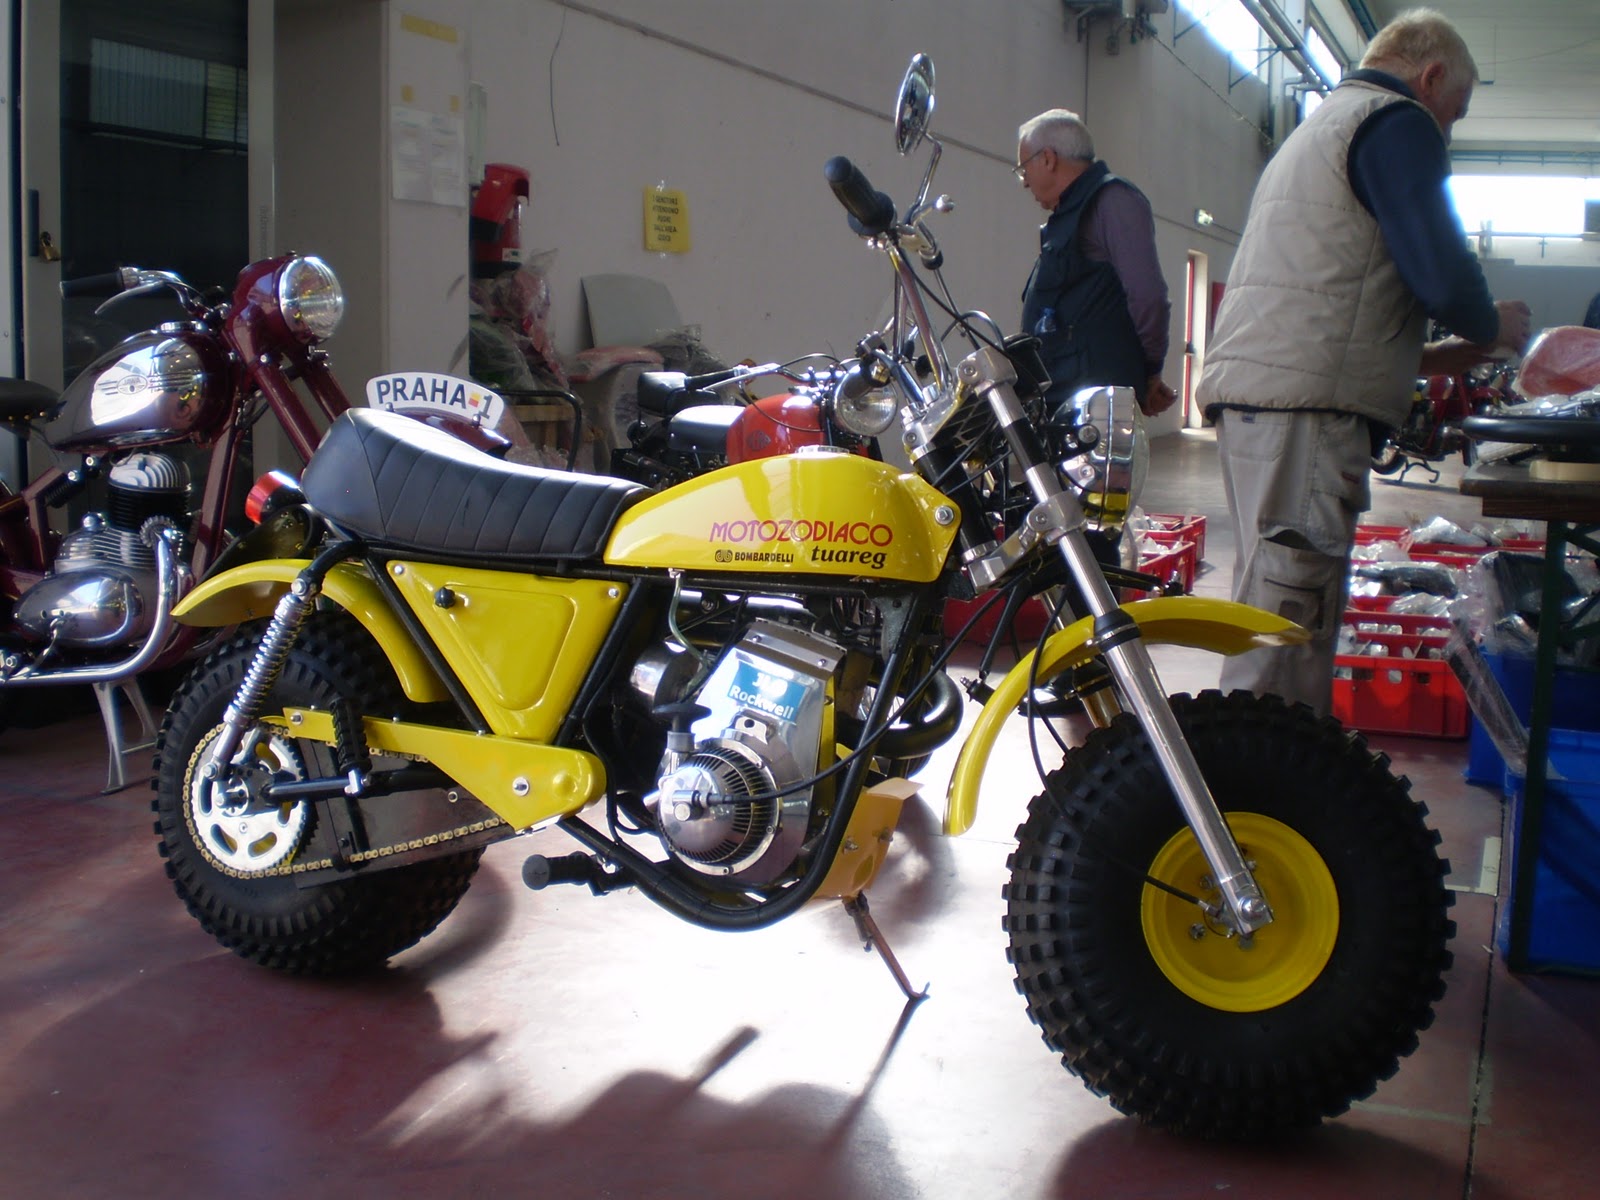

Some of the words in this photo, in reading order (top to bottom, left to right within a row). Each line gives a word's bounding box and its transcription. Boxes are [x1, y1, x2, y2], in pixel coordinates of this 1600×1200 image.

[375, 377, 467, 410] PRAHA
[709, 519, 893, 547] MOTOZODIACO
[734, 552, 794, 563] BOMBARDELLI
[811, 545, 887, 570] tuareg
[729, 685, 794, 719] Rockwell
